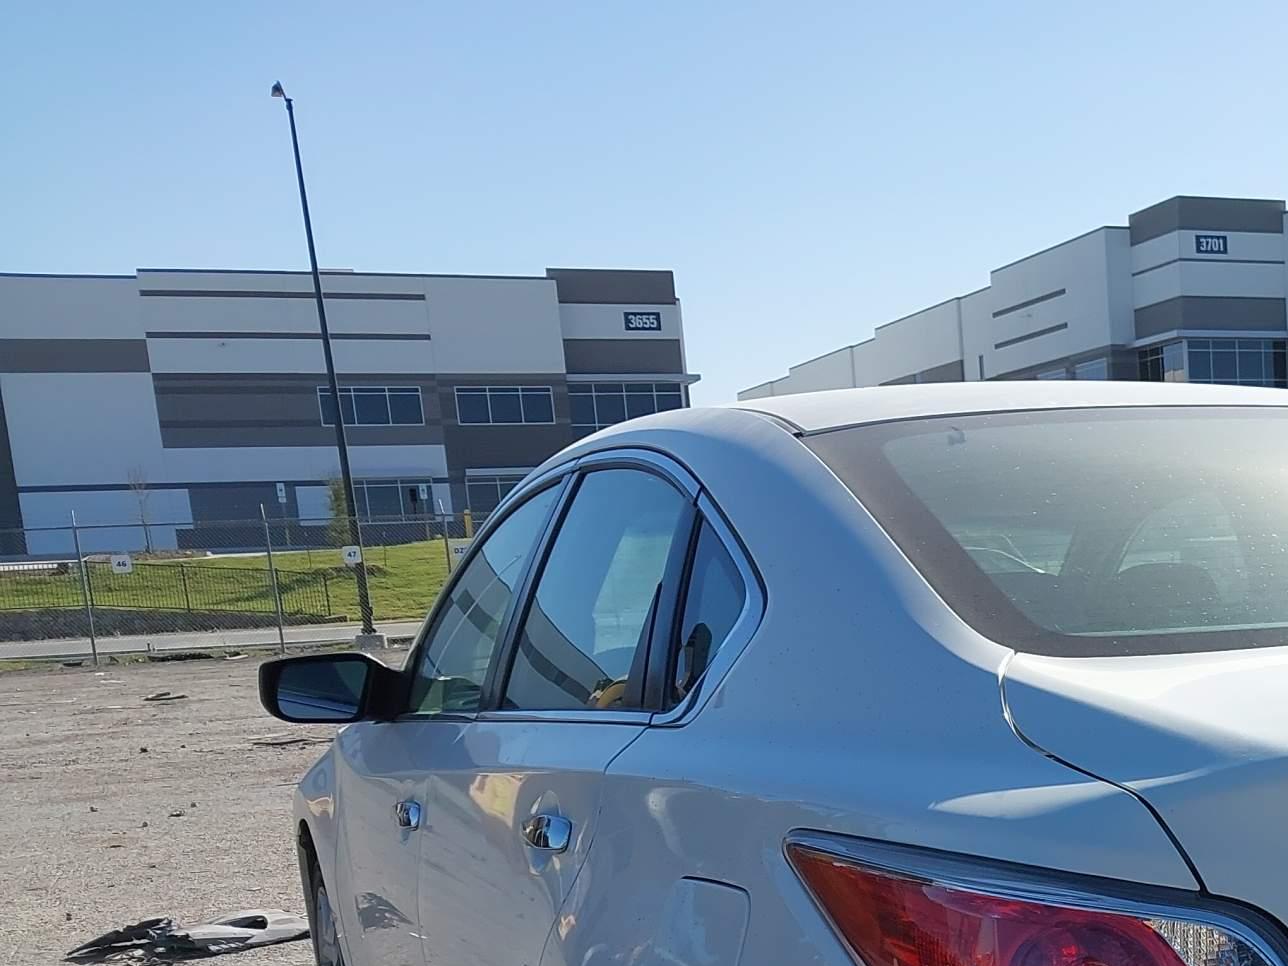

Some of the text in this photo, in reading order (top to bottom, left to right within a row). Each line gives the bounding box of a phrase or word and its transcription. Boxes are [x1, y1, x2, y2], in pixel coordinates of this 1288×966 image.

[1199, 238, 1224, 252] 3701
[628, 314, 657, 328] 3655
[347, 550, 357, 558] 47
[115, 560, 127, 568] 46
